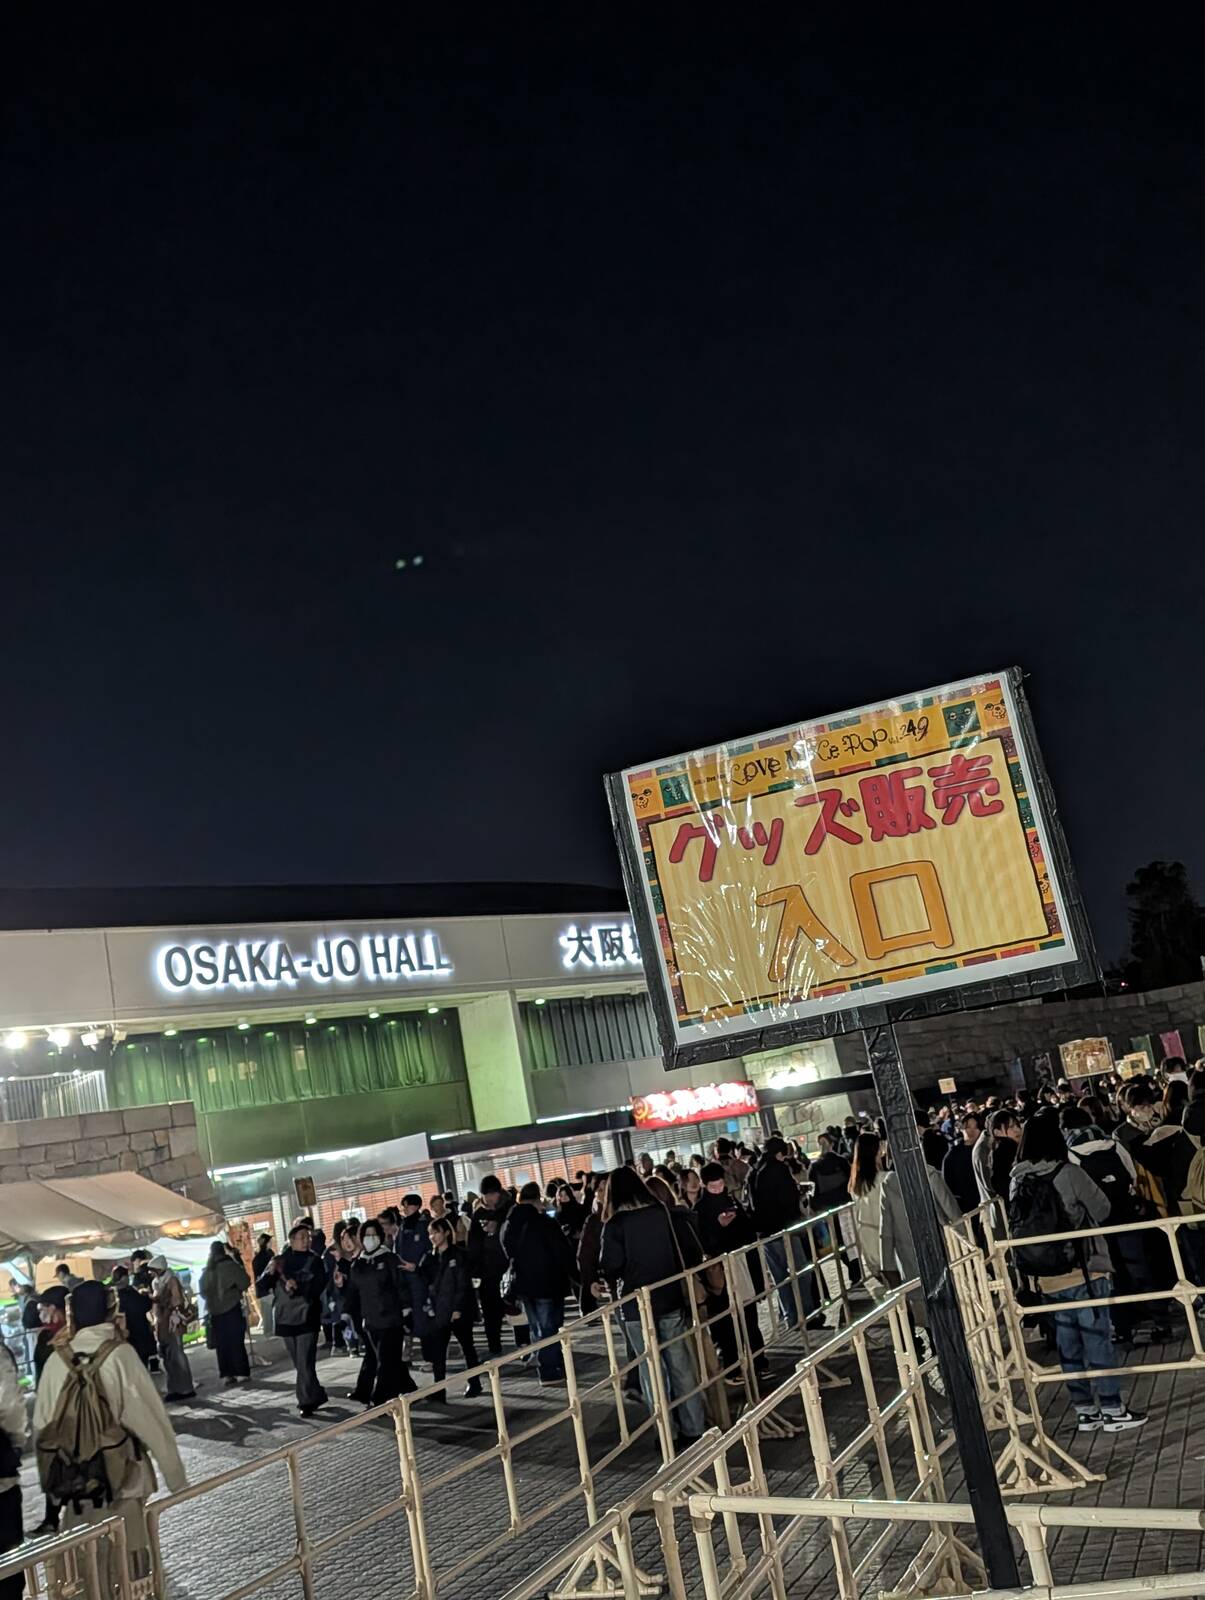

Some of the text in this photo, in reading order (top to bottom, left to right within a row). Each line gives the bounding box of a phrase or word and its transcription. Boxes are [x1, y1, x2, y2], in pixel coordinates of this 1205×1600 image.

[668, 754, 1004, 882] グッズ販売
[164, 936, 452, 987] OSAKA-JO HALL
[755, 860, 954, 982] 入口
